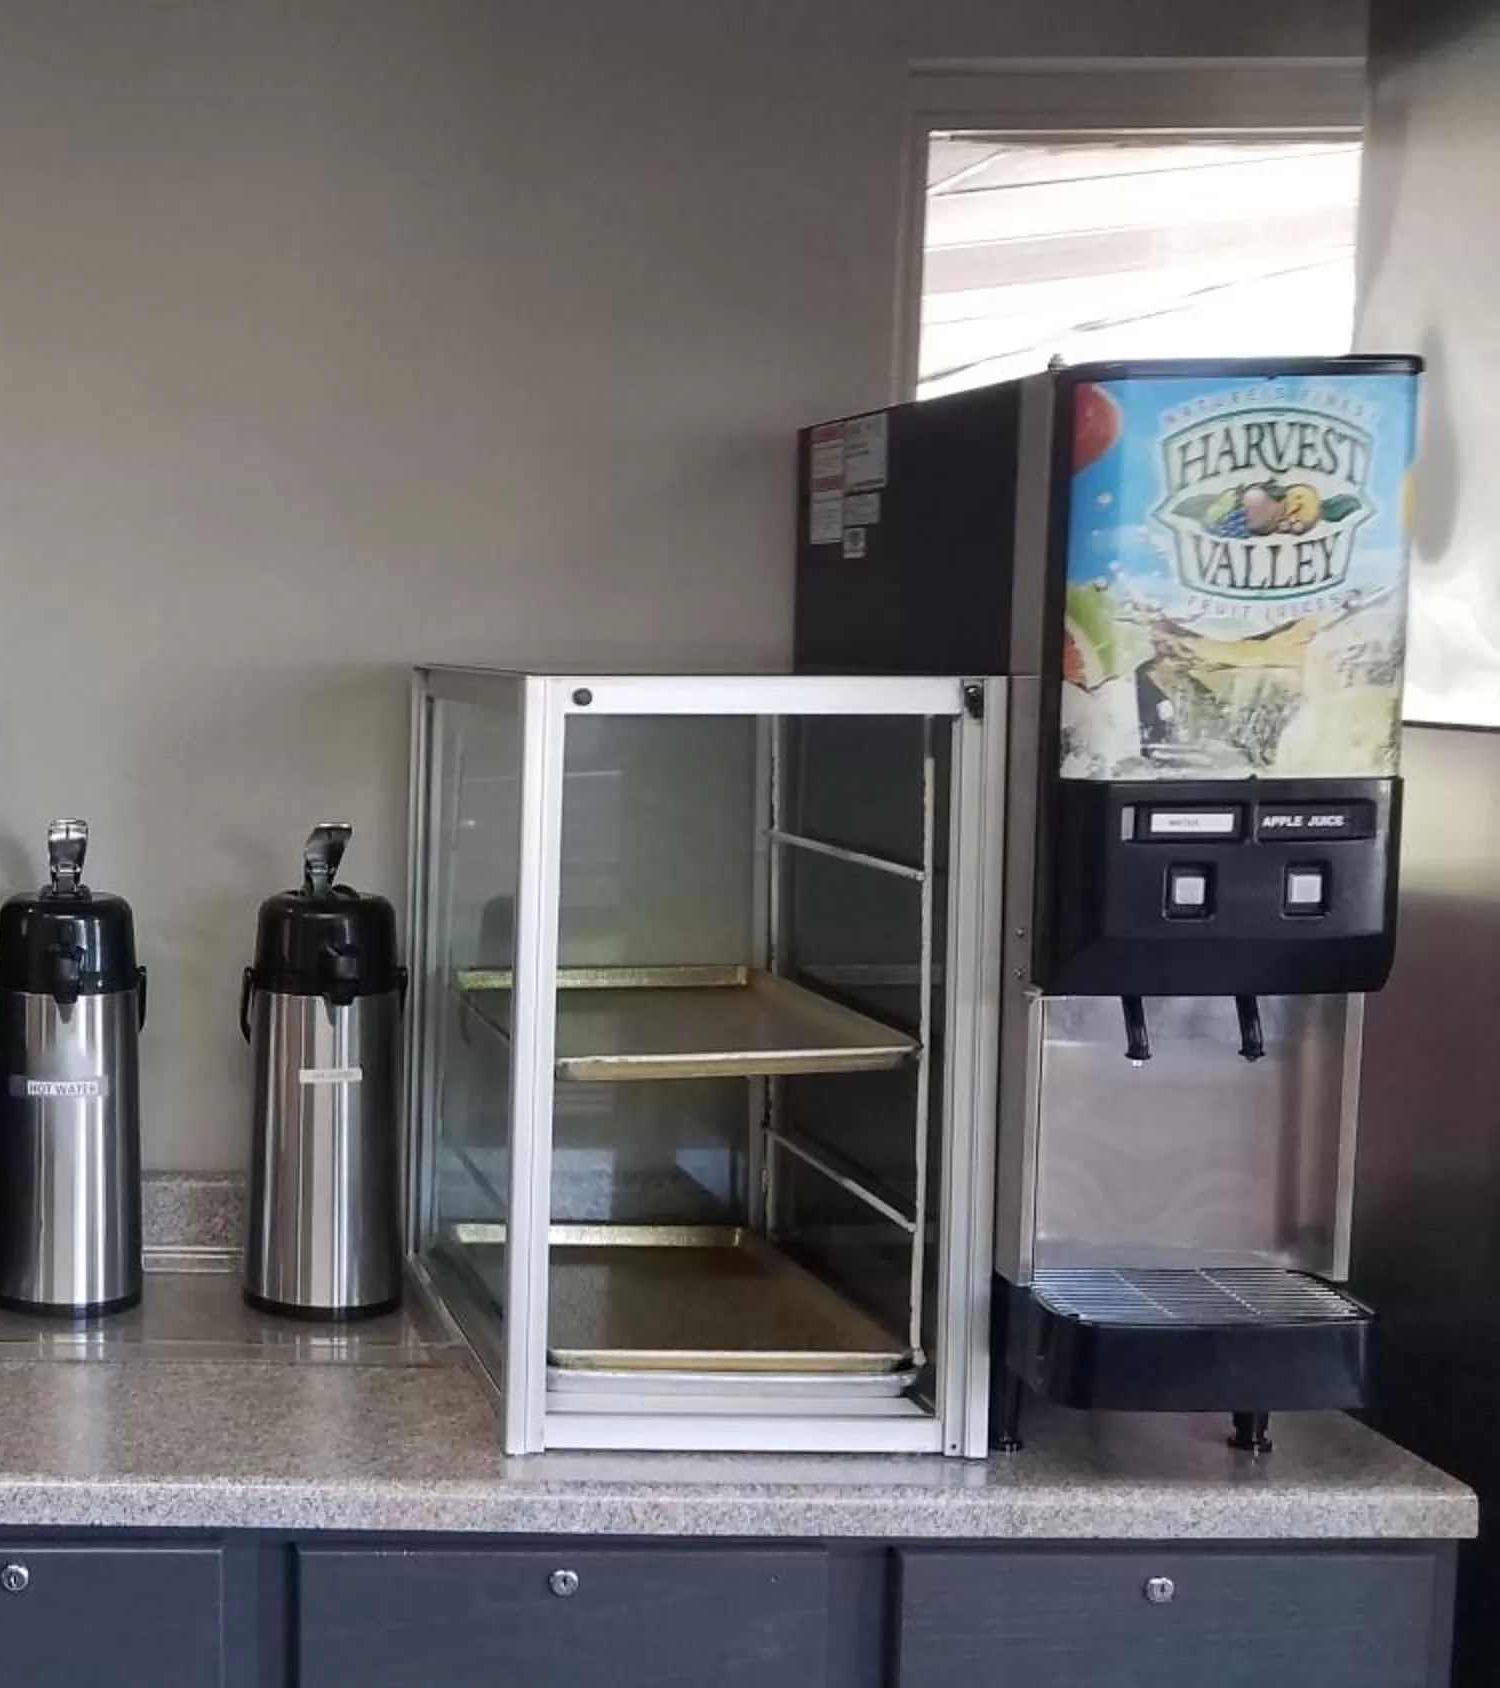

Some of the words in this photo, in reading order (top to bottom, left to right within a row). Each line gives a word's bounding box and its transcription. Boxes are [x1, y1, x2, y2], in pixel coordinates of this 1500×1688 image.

[1176, 421, 1369, 490] HARVEST
[1191, 531, 1345, 590] VALLEY
[1262, 815, 1303, 828] APPLE
[1308, 815, 1345, 827] JUICE
[29, 1083, 52, 1094] HOT
[55, 1083, 97, 1095] WATER
